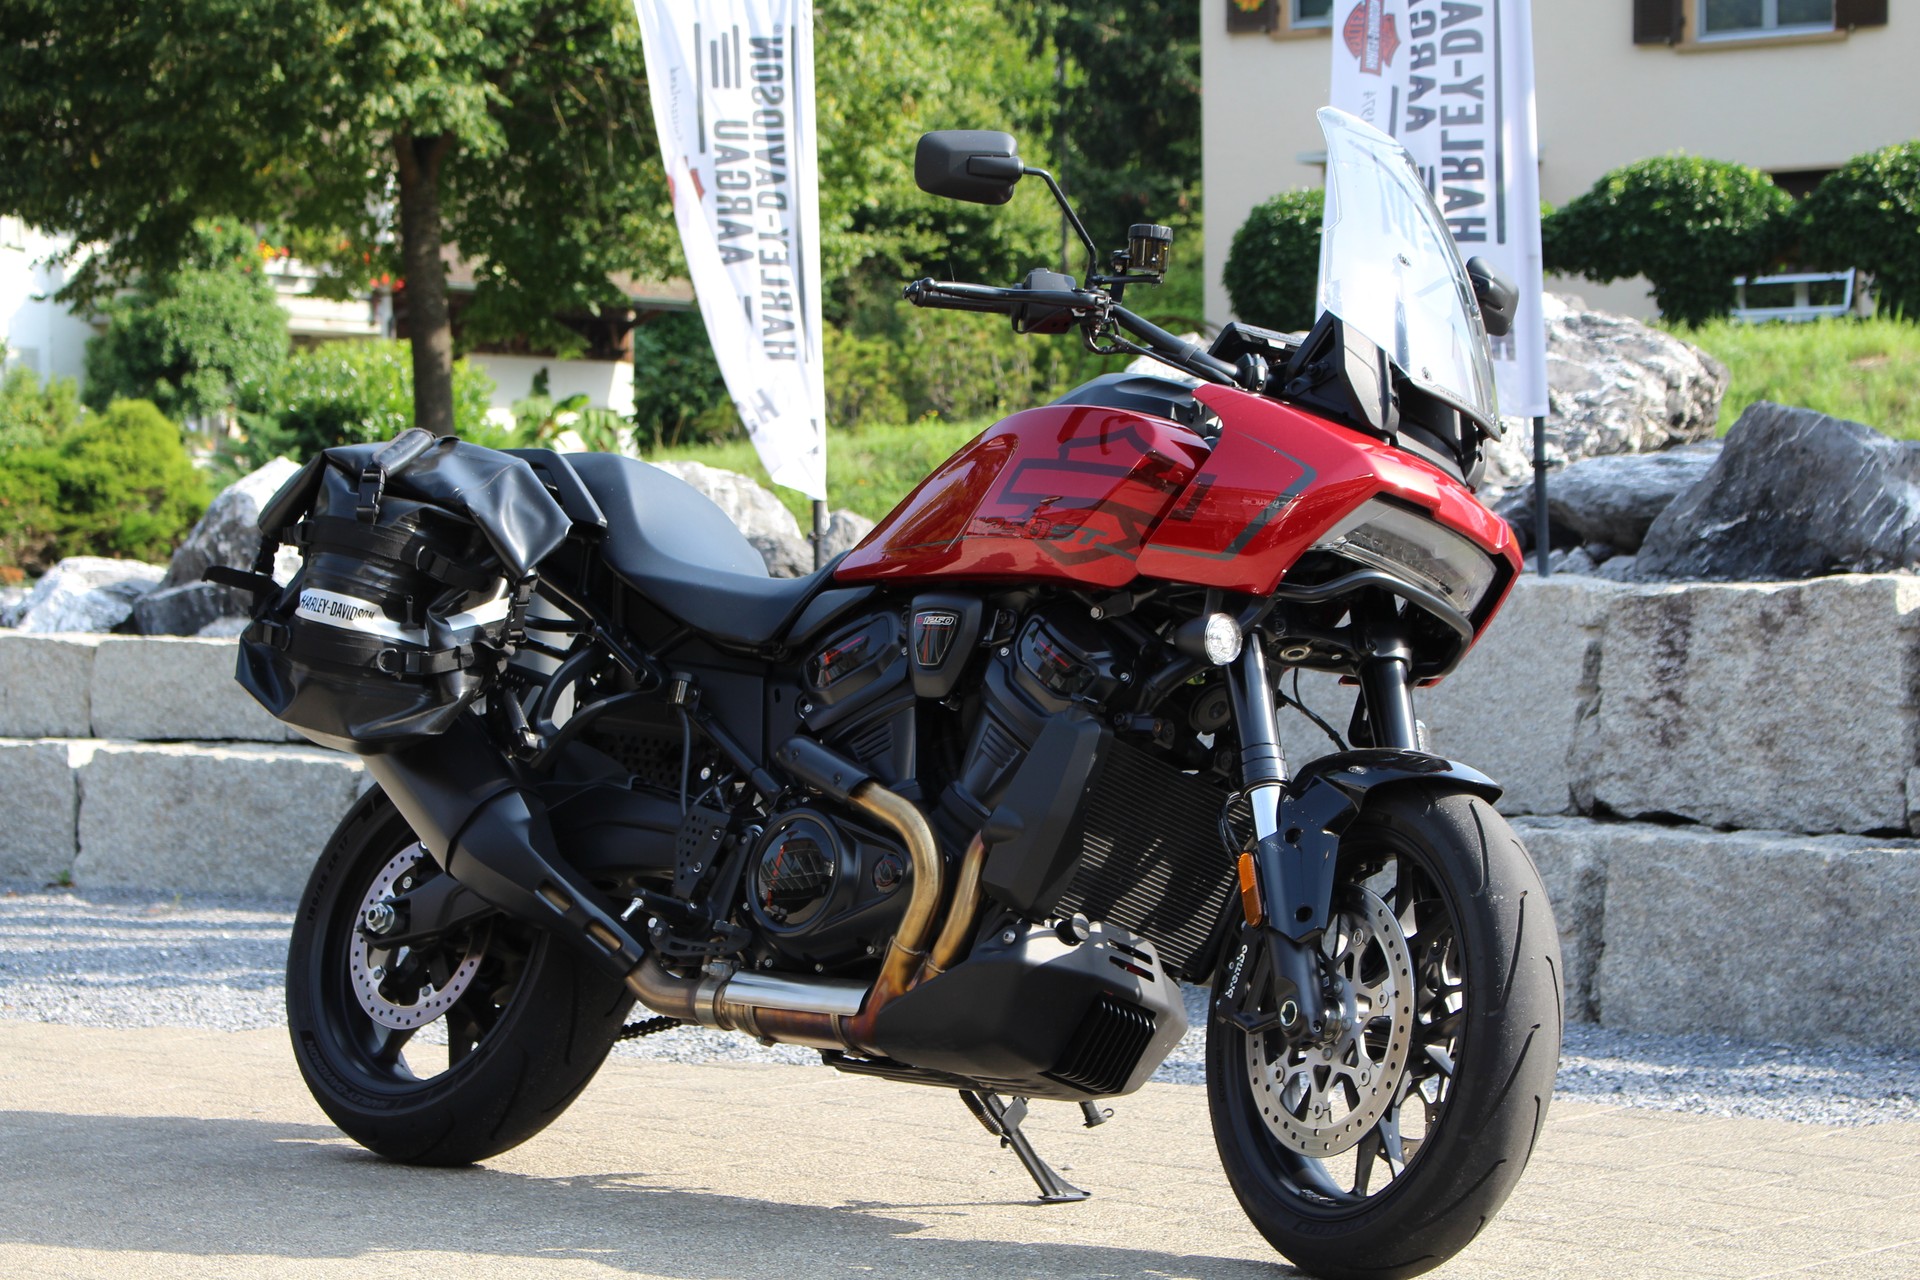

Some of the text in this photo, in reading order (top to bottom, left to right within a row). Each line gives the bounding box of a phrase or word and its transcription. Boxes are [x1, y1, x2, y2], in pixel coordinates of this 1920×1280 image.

[300, 594, 376, 621] HARLEY-DAVIDSON
[923, 616, 954, 625] 1250
[1225, 944, 1248, 998] brembo
